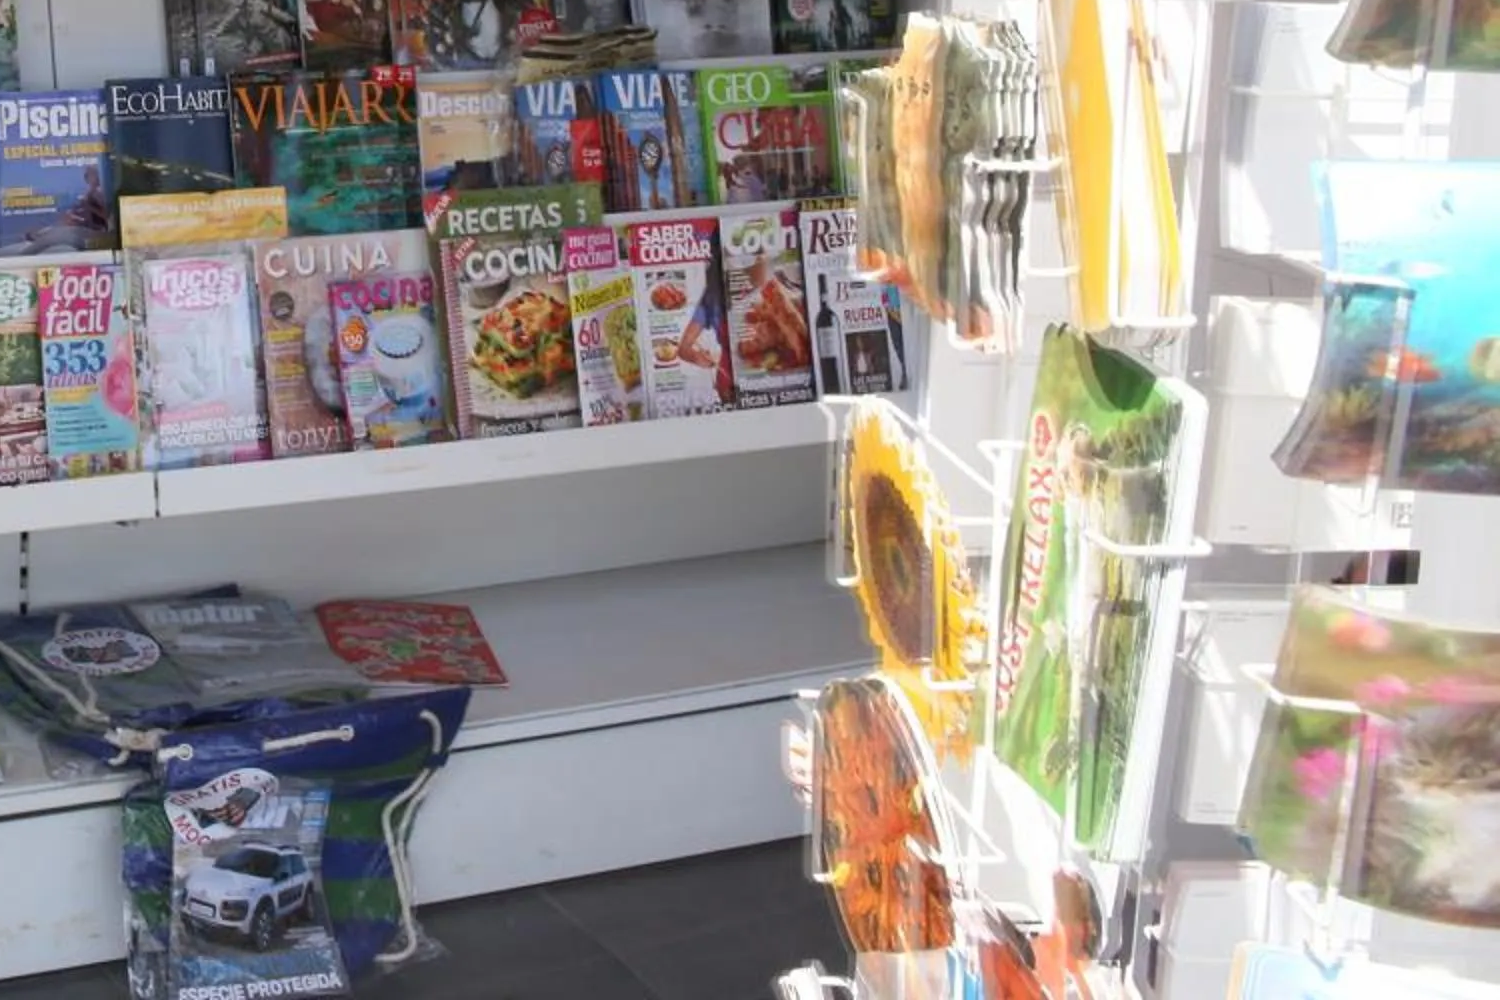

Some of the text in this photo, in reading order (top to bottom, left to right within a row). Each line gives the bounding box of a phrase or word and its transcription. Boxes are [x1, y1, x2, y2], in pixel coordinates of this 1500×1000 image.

[526, 79, 576, 117] VIA
[707, 71, 771, 105] GEO
[236, 79, 398, 137] VIAJAR
[718, 105, 824, 151] CUBA
[448, 201, 563, 236] RECETAS
[638, 224, 694, 246] SABER
[263, 242, 391, 278] CUINA
[640, 241, 713, 264] COCINAR
[53, 268, 112, 302] todo
[46, 299, 105, 335] fácil
[844, 307, 883, 321] RUEDA
[578, 317, 601, 348] 60
[45, 340, 106, 376] 353
[1019, 466, 1054, 606] RELAX
[171, 773, 241, 806] GRATIS
[247, 971, 343, 997] PROTEGIDA
